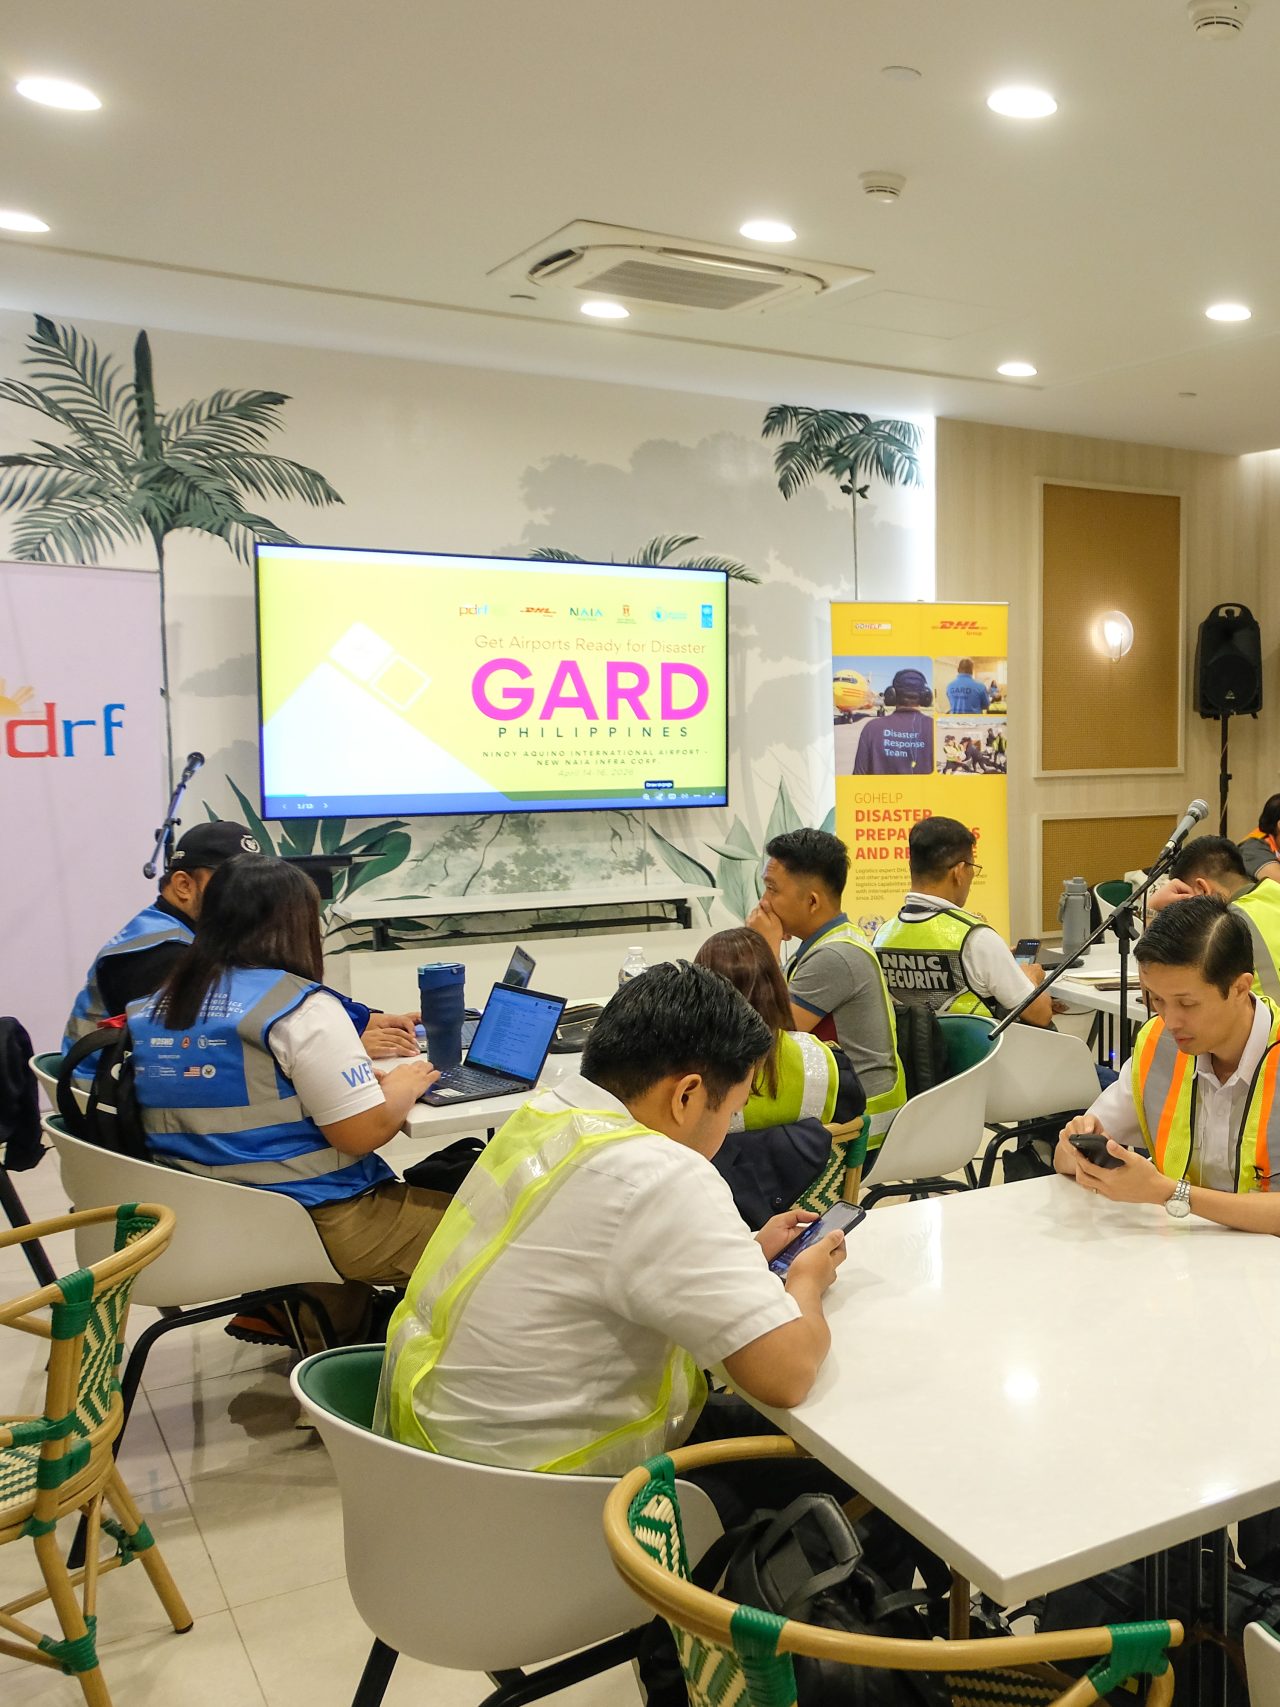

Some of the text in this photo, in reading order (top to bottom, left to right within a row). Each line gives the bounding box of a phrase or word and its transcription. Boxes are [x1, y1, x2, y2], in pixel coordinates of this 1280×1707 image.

[570, 607, 604, 617] NAIA
[939, 620, 979, 630] DHL
[474, 635, 706, 655] Get Airports Ready for Disaster
[471, 657, 710, 721] GARD
[0, 702, 125, 758] drf
[498, 727, 689, 738] PHILIPPINES
[883, 729, 919, 739] Disaster
[883, 739, 925, 749] Response
[570, 749, 654, 757] INTERNATIONAL
[884, 748, 908, 758] Team
[536, 758, 560, 766] NEW
[854, 792, 903, 804] GOHELP
[855, 808, 933, 823] DISASTER
[855, 846, 890, 860] AND
[881, 953, 942, 971] NNIC
